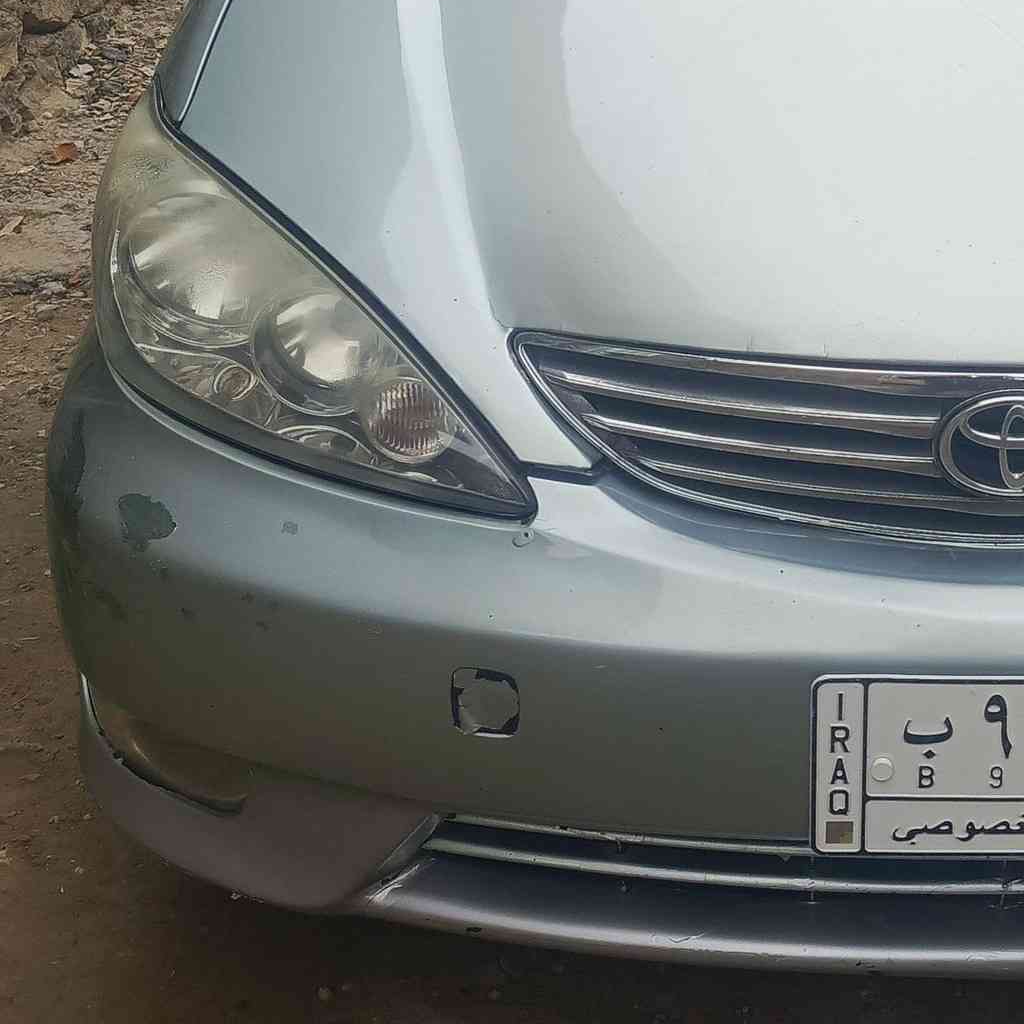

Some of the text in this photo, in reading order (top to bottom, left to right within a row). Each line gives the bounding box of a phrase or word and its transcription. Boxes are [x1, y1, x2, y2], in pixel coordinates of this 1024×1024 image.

[829, 693, 850, 817] IRAQ
[903, 716, 954, 760] ب
[917, 765, 935, 789] B
